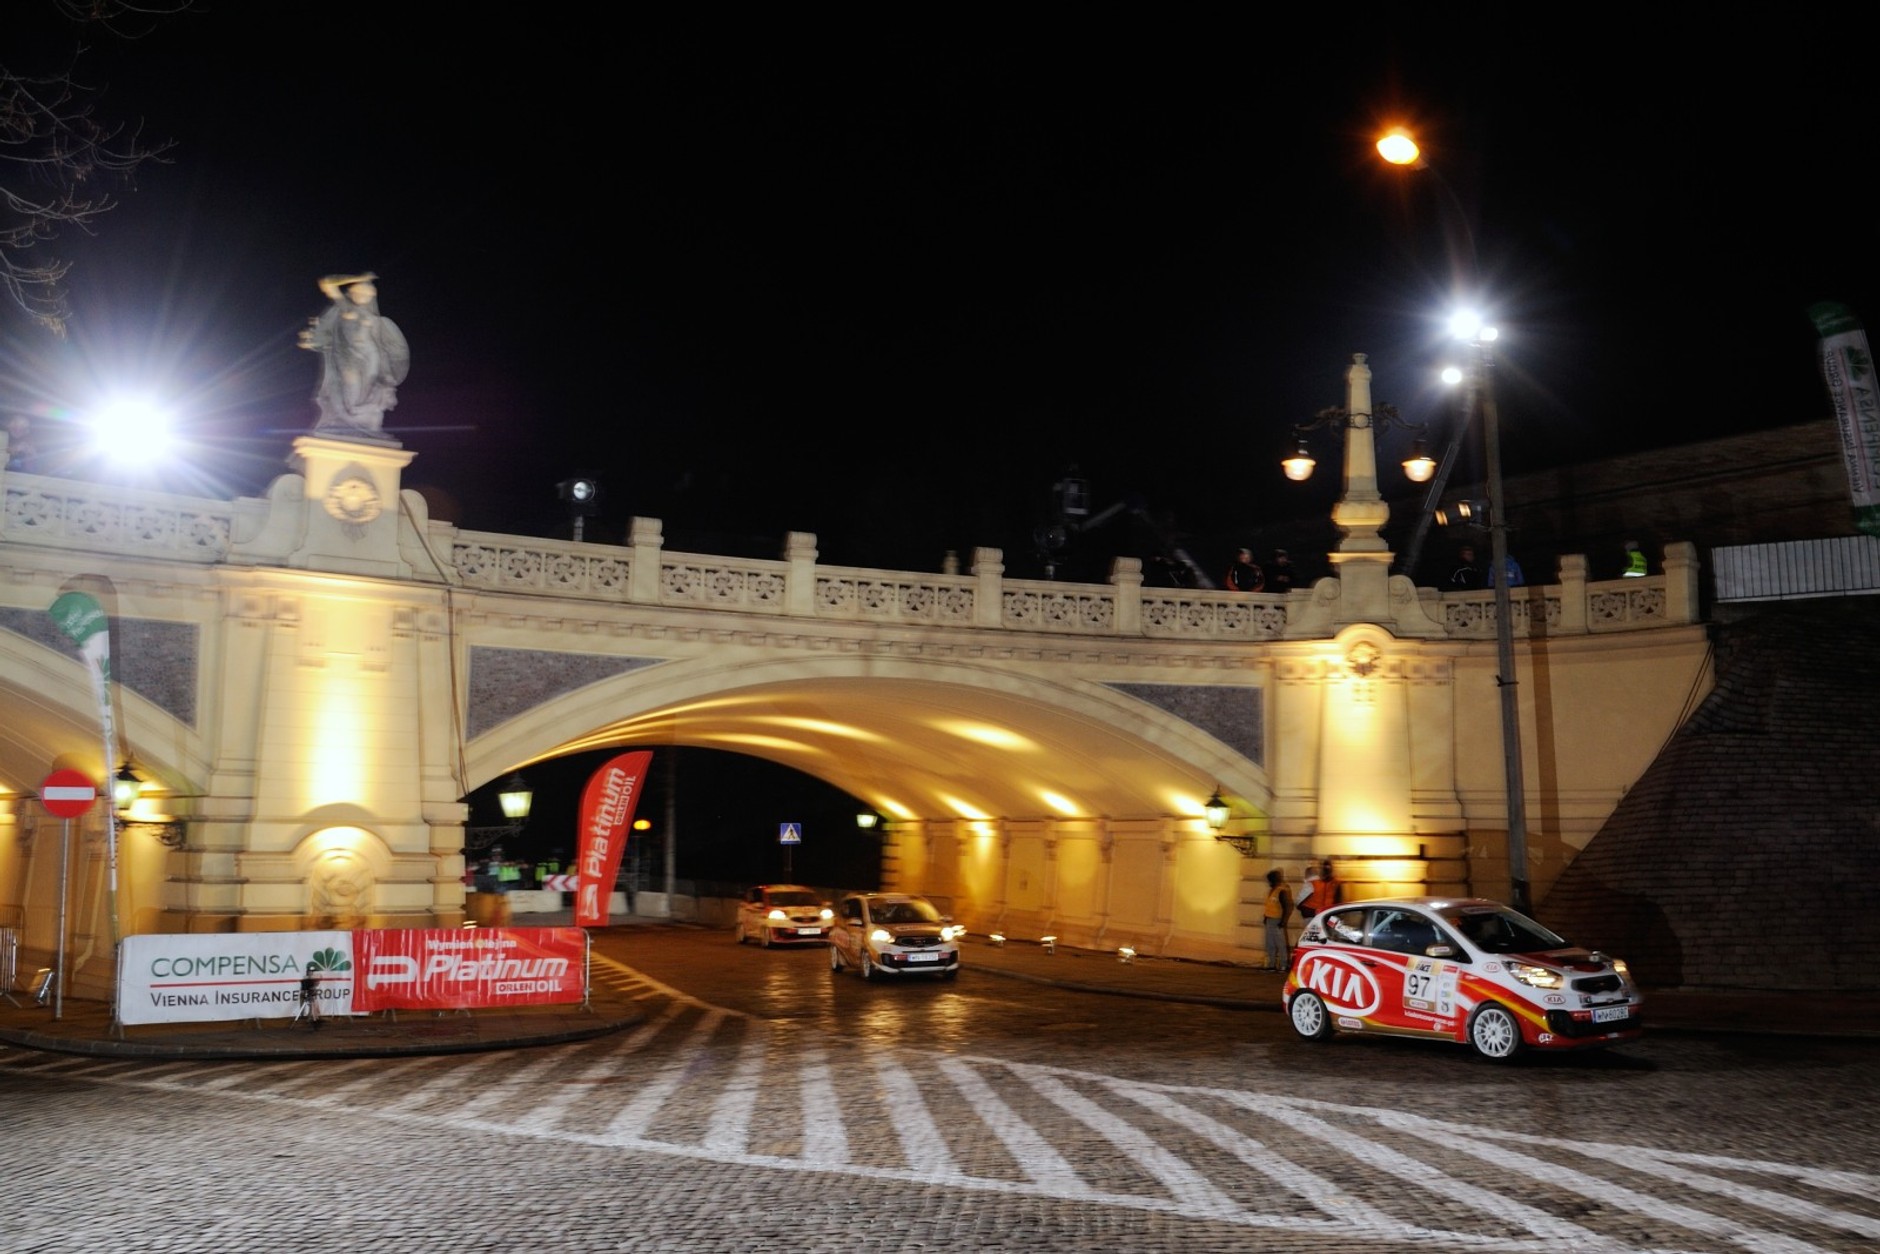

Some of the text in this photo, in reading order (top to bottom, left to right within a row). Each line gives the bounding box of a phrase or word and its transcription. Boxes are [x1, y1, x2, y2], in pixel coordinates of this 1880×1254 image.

[622, 775, 636, 795] OIL
[584, 767, 626, 878] Platinum
[151, 954, 300, 978] COMPENSA
[424, 953, 569, 982] Platinum
[499, 980, 562, 992] ORLEN OIL
[1308, 958, 1364, 1008] KIA
[1408, 974, 1431, 998] 97
[151, 988, 350, 1007] VIENNA INSURANCE ROUP
